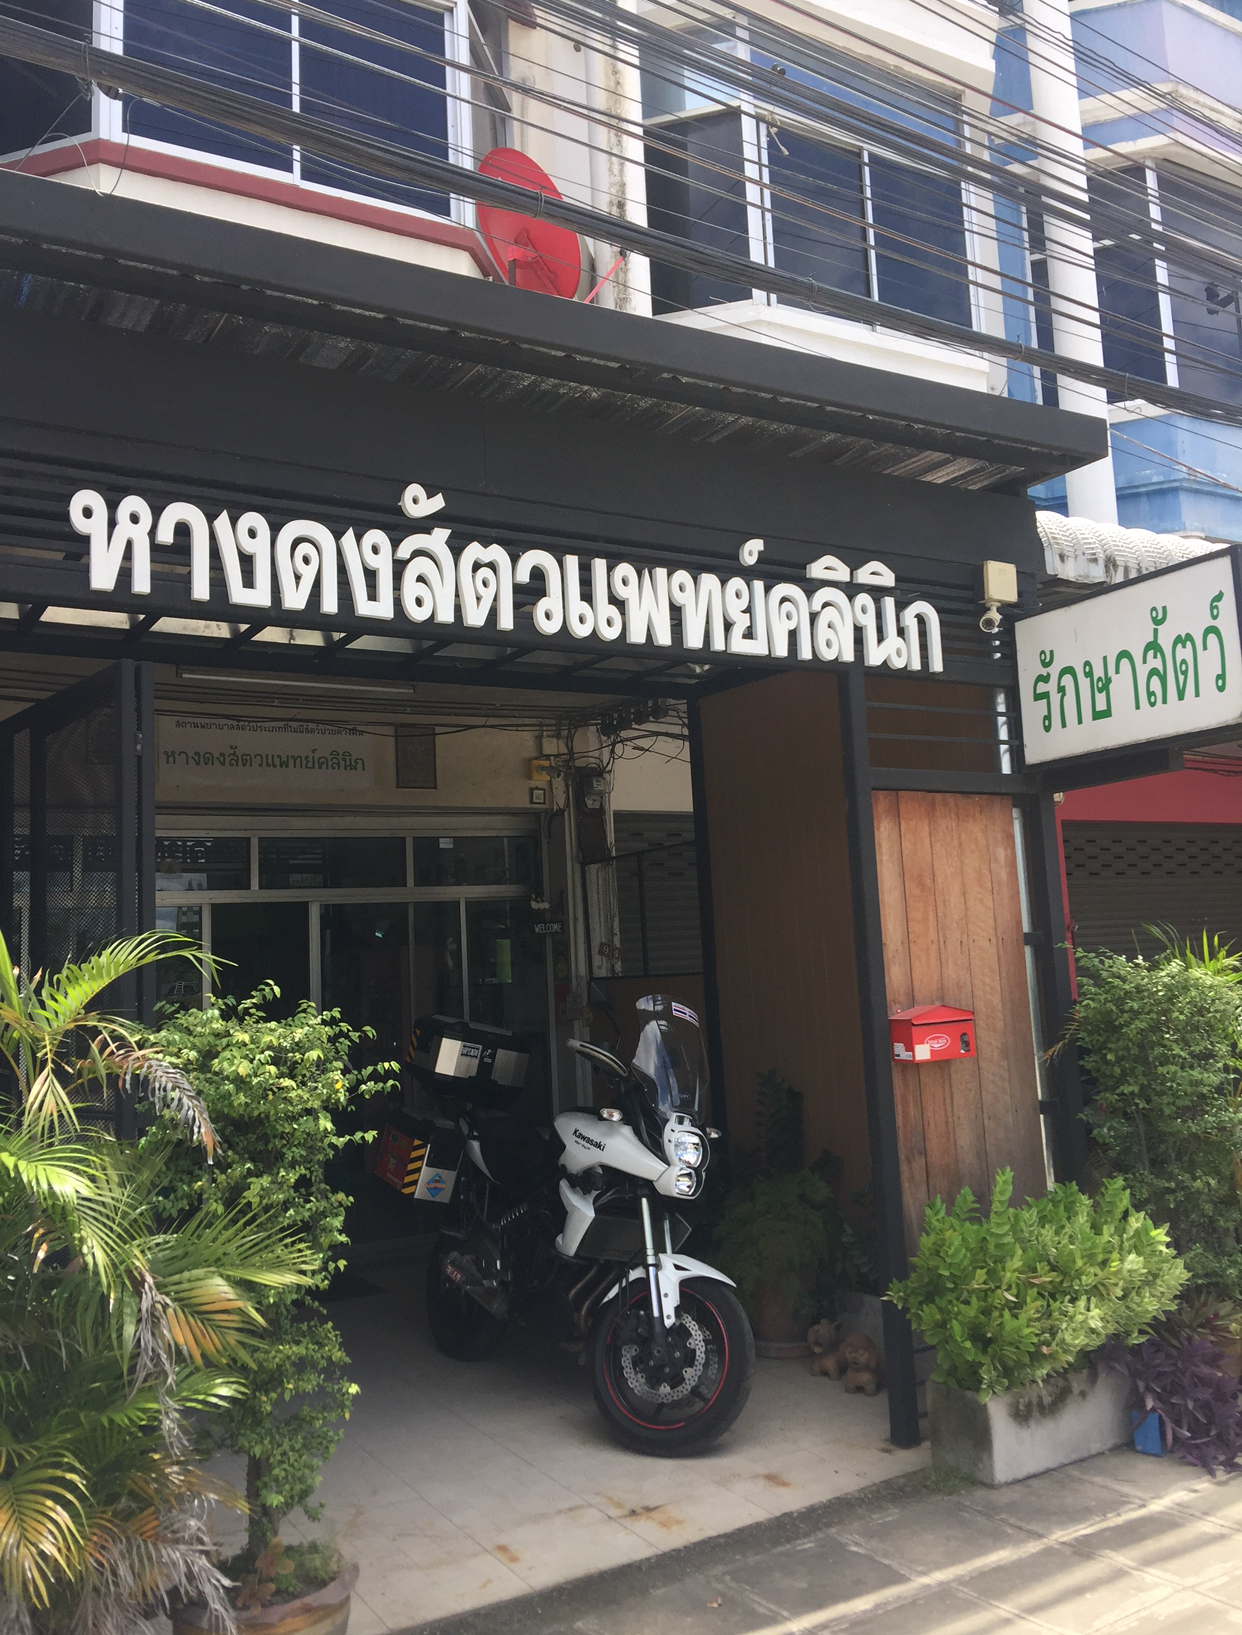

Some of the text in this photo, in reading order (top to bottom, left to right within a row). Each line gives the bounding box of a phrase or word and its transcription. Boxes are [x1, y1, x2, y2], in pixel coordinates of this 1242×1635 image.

[69, 482, 943, 674] หางดงสัตวแพทย์คลินิก
[1033, 590, 1227, 733] รักษาสัตว์
[163, 744, 366, 772] หางดงสัตวแพทย์คลินิก
[534, 923, 563, 933] WELCOME
[572, 1128, 606, 1152] Kawasaki
